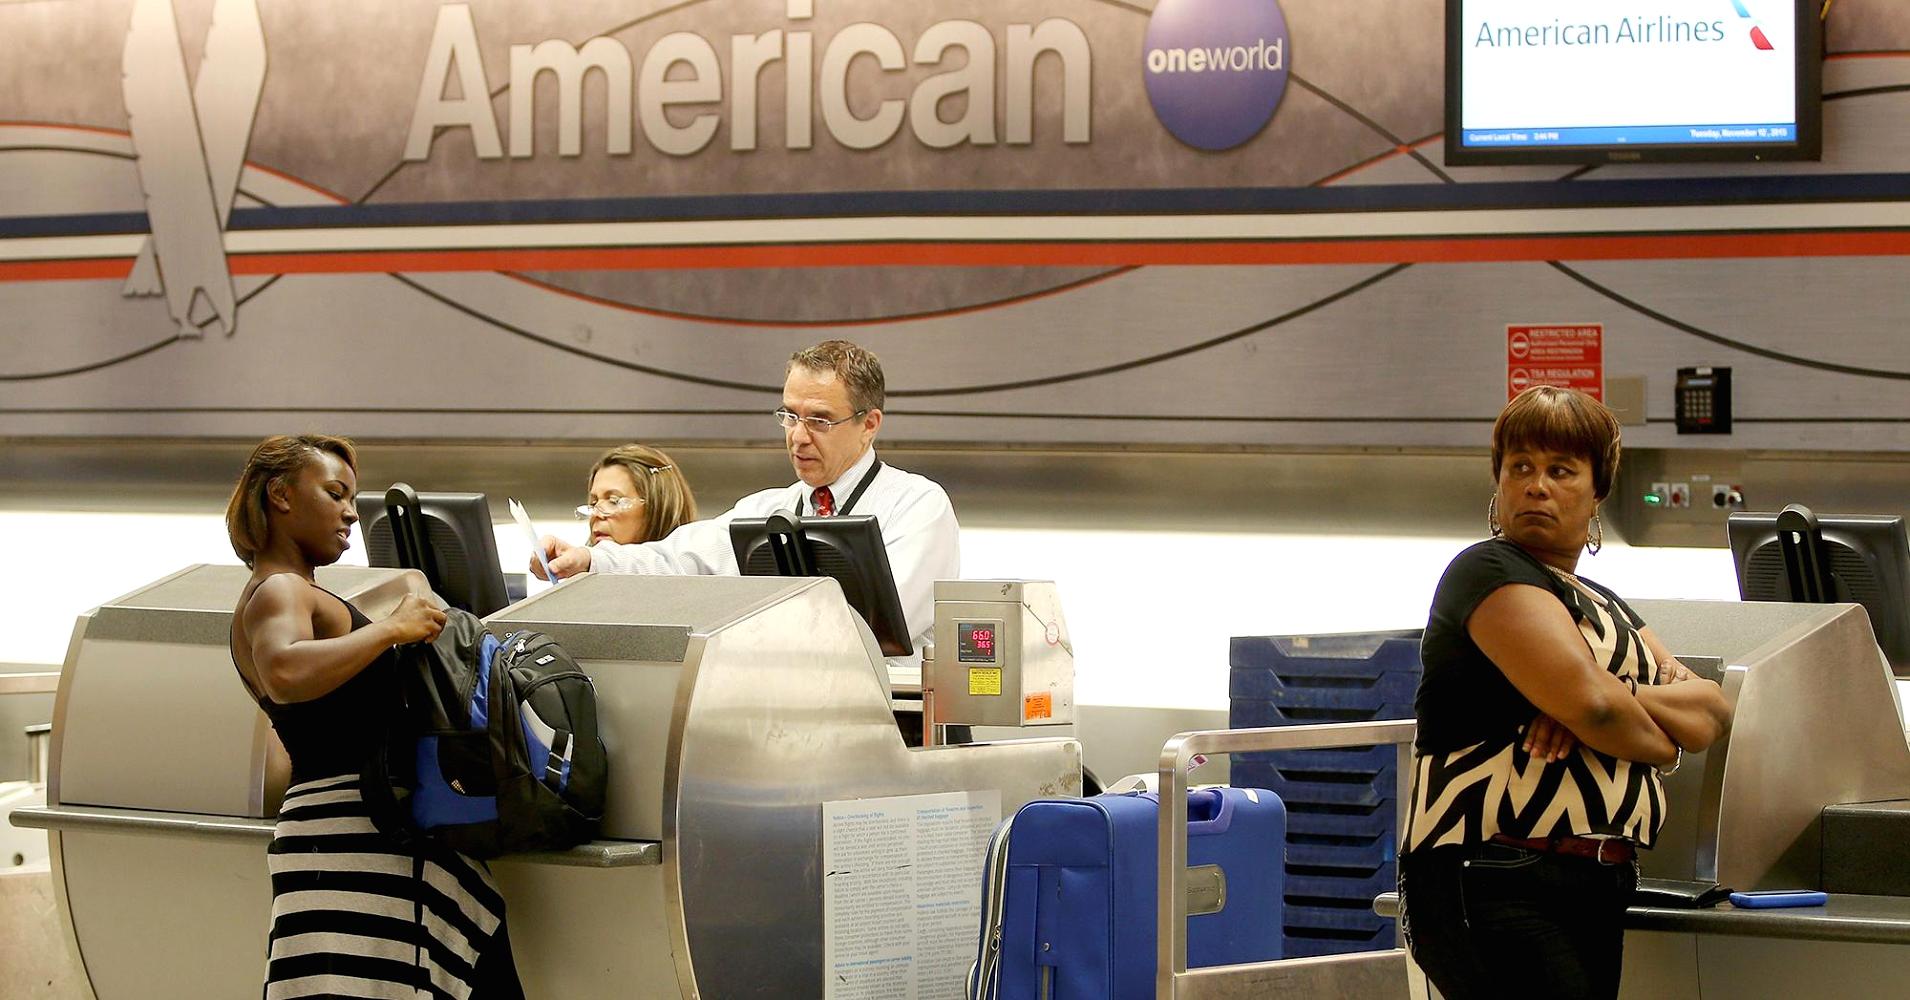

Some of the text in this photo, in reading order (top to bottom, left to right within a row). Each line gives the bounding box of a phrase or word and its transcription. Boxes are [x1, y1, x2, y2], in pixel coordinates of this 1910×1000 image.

[1475, 15, 1724, 48] American Airlines
[1146, 37, 1283, 76] oneworld
[403, 0, 1093, 162] American
[1529, 329, 1598, 337] RESTRICTED AREA
[1547, 369, 1595, 378] REGULATION
